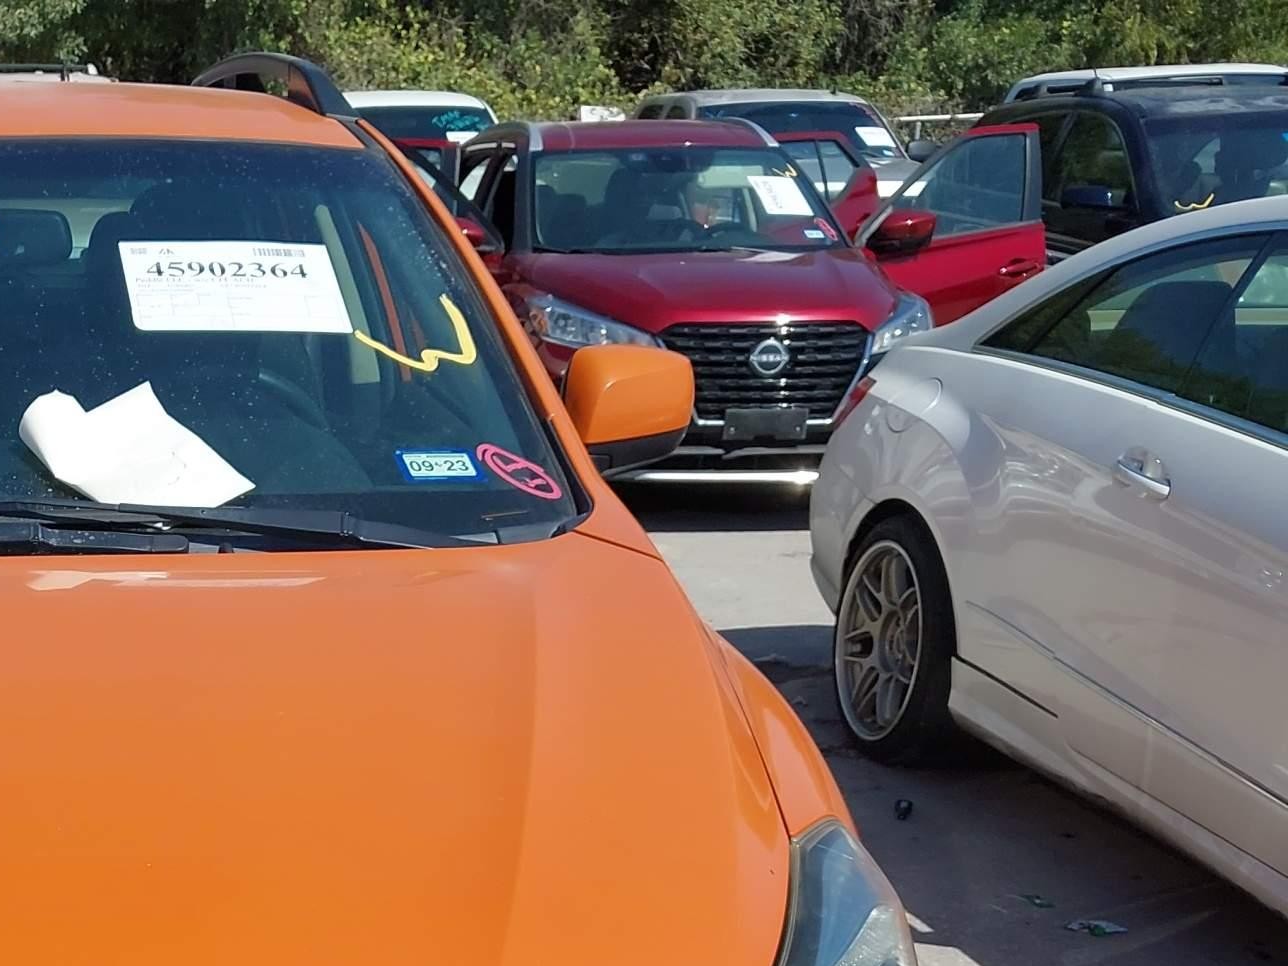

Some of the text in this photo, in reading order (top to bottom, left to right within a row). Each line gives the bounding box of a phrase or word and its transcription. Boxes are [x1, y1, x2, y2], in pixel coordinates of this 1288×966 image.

[146, 261, 308, 279] 45902364
[409, 460, 469, 472] 09 23
